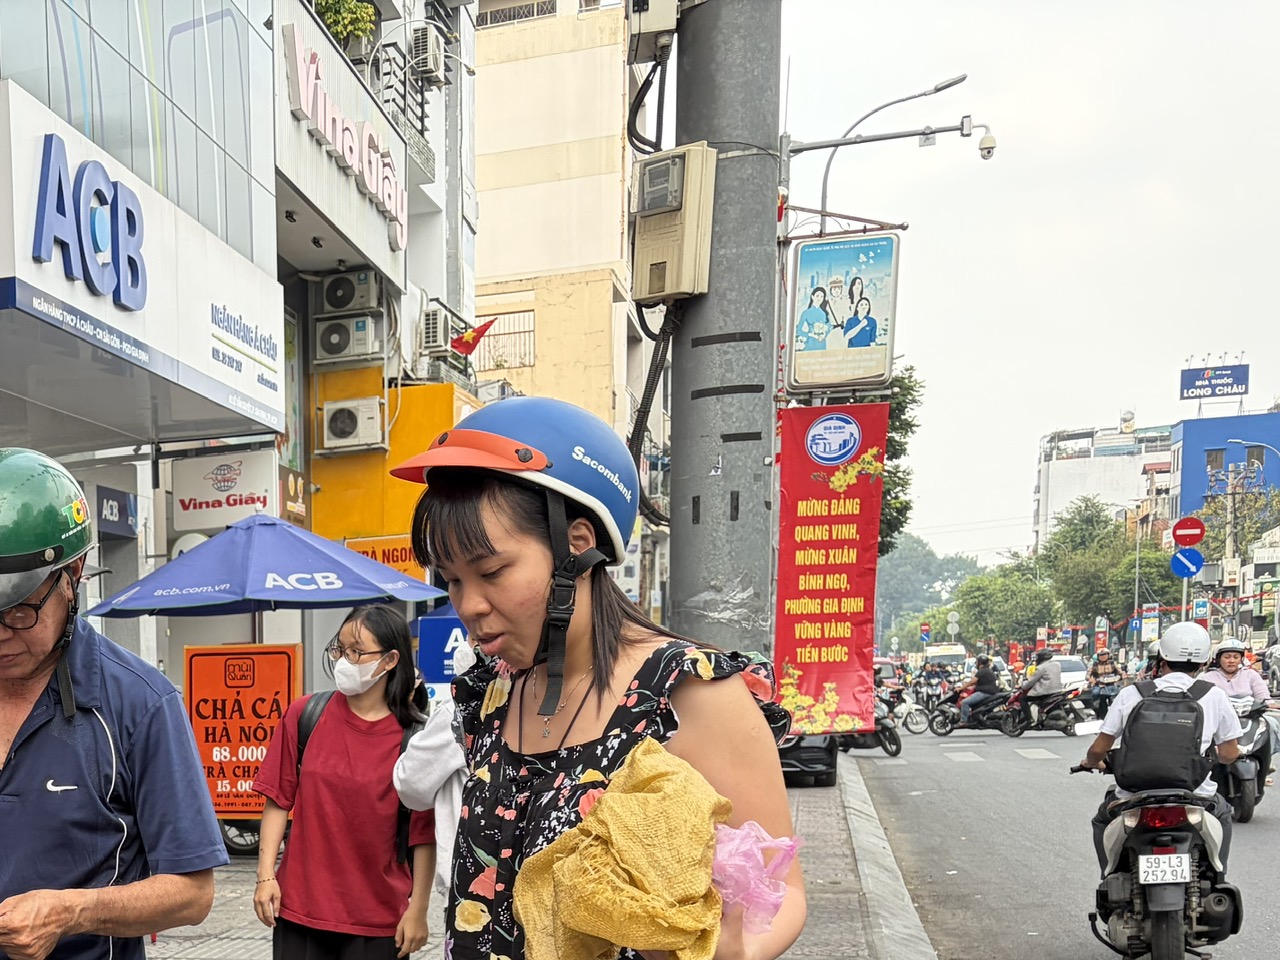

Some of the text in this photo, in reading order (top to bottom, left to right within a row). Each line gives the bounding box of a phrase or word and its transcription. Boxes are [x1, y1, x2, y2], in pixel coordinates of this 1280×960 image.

[32, 133, 148, 312] ACB
[1183, 384, 1246, 397] LONG CHÂU
[571, 446, 632, 503] Sacombank
[102, 498, 119, 522] ACB
[797, 493, 861, 517] MỪNG ĐẢNG
[795, 523, 860, 543] QUANG VINH,
[795, 545, 857, 566] MỪNG XUÂN
[154, 582, 231, 597] acb.com.vn
[265, 572, 343, 591] ACB
[798, 571, 850, 593] BÍNH NGỌ,
[784, 595, 864, 617] PHƯỜNG GIA ĐỊNH
[794, 619, 852, 640] VỮNG VÀNG
[796, 642, 849, 663] TIẾN BƯỚC
[227, 661, 252, 672] mùi
[195, 690, 283, 720] CHẢ CÁ
[204, 721, 231, 744] HÀ
[212, 745, 267, 762] 68.000
[232, 766, 260, 778] CHA
[216, 780, 254, 792] 15.00
[1146, 855, 1183, 870] 59-L3
[1143, 869, 1187, 883] 252.94
